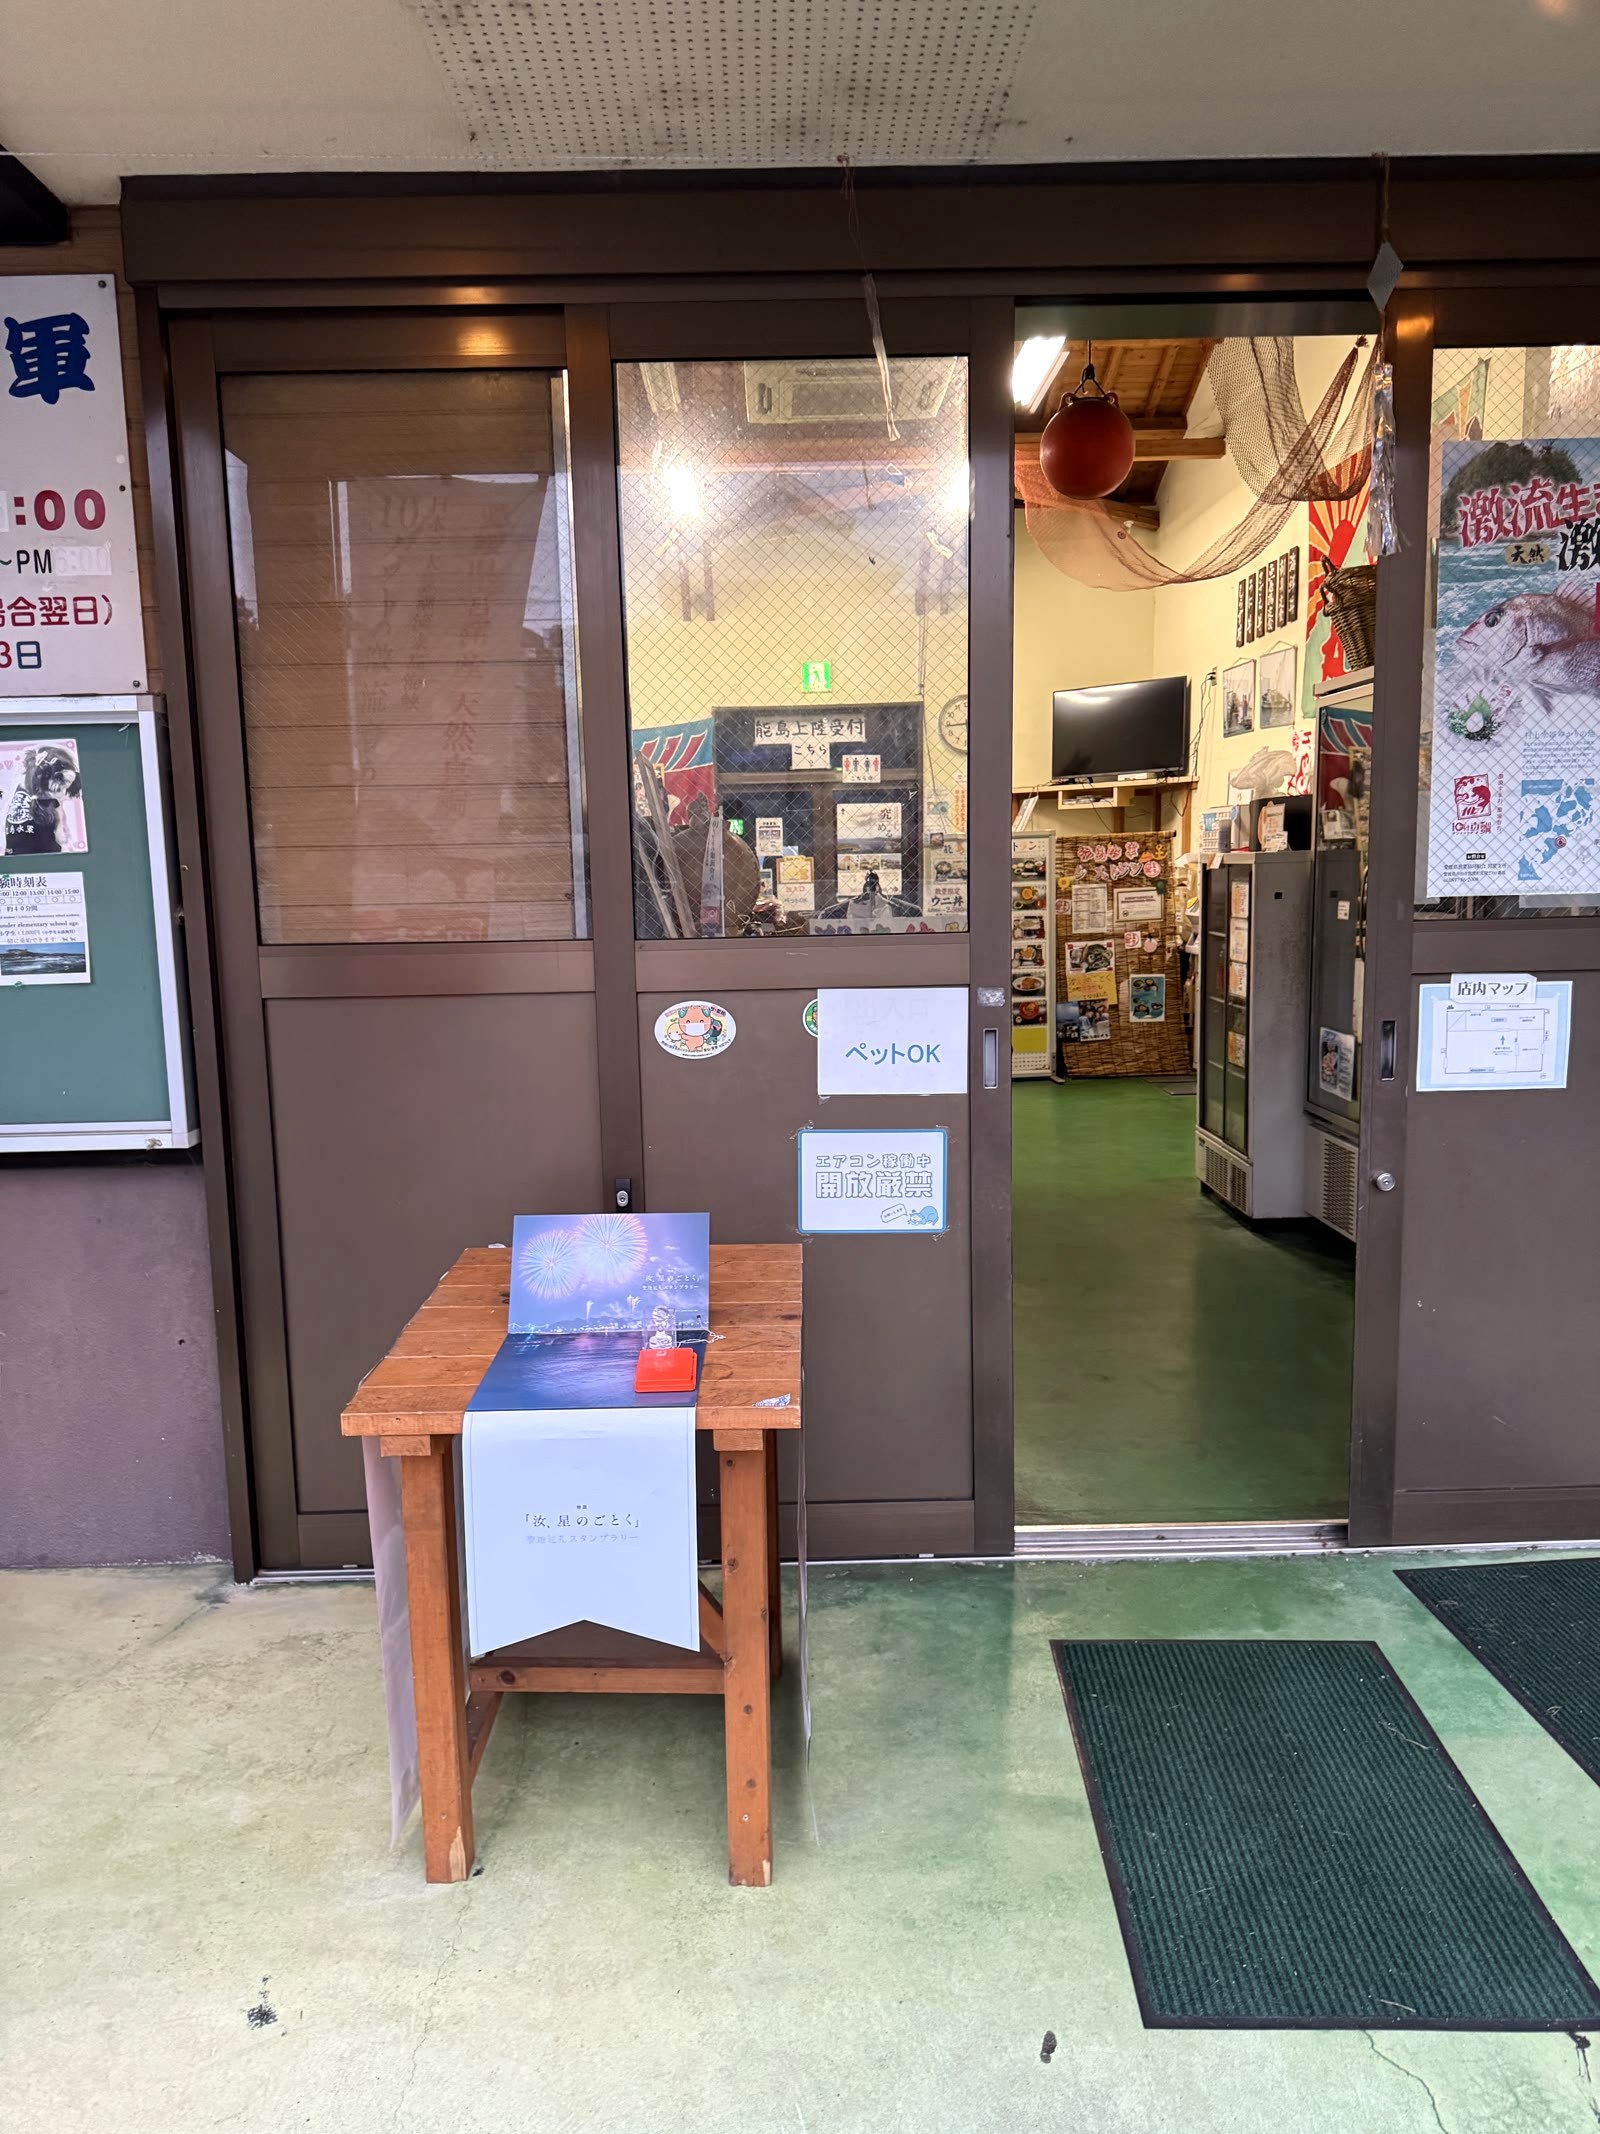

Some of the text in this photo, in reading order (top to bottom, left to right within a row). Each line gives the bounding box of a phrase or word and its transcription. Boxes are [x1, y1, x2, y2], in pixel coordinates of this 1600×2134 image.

[4, 312, 96, 405] 軍
[1458, 478, 1600, 548] 激流生
[1510, 544, 1545, 563] 天然
[755, 718, 864, 738] 能島上陸受付
[794, 743, 828, 756] こちら
[931, 896, 964, 907] ウニ丼
[1457, 981, 1529, 996] 店内マップ
[845, 1042, 941, 1065] ペットOK
[816, 1153, 931, 1168] エアコン稼働中
[816, 1171, 932, 1198] 開放厳禁
[525, 1513, 639, 1529] 「汝、星のごとく」
